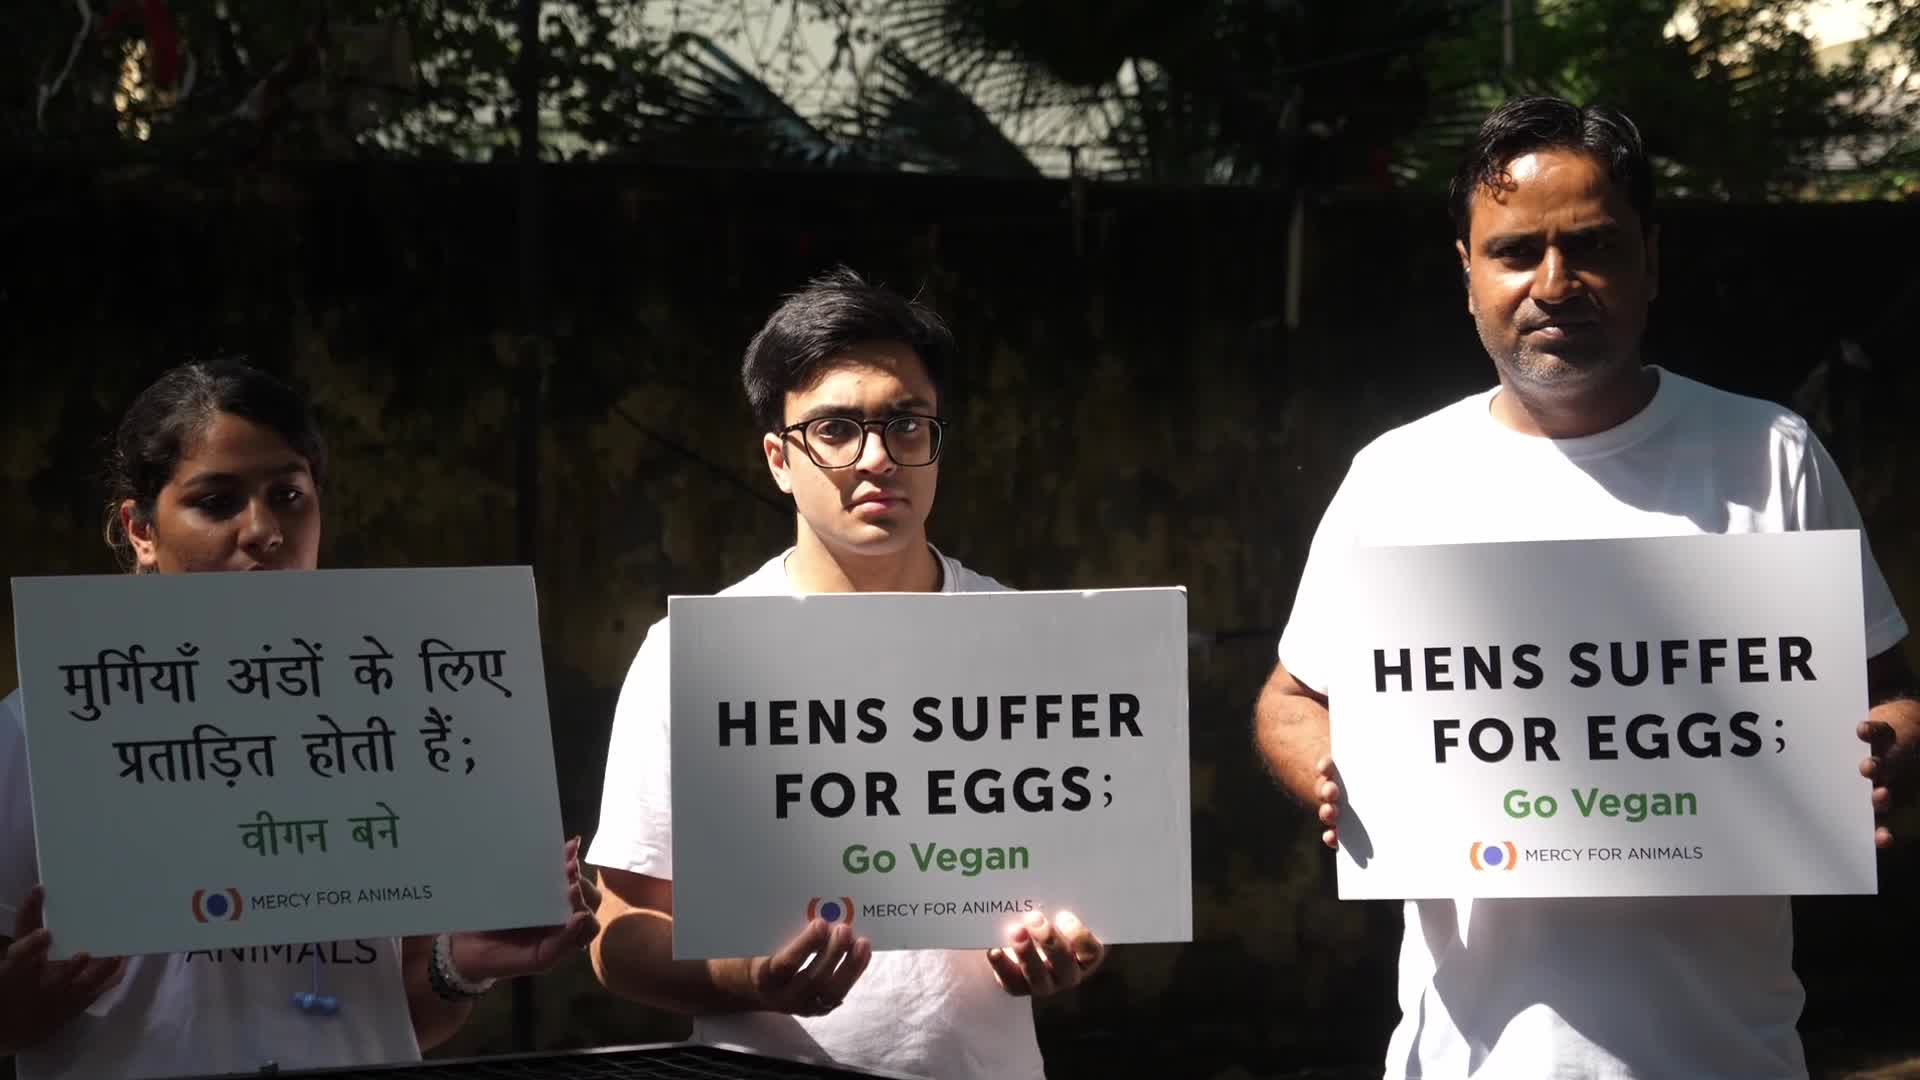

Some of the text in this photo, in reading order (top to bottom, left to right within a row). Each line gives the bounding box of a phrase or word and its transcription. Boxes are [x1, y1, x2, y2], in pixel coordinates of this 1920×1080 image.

[58, 636, 512, 722] मुर्गियाँ अंडों के लिए
[1374, 636, 1817, 692] HENS SUFFER
[719, 694, 1143, 746] HENS SUFFER
[1434, 711, 1785, 763] FOR EGGS;
[112, 707, 475, 788] प्रताड़ित होती हैं;
[776, 766, 1112, 819] FOR EGGS;
[1504, 788, 1696, 822] Go Vegan
[238, 802, 400, 856] वीगन बने
[1526, 846, 1703, 861] MERCY FOR ANIMALS
[843, 843, 1028, 877] Go Vegan
[251, 885, 432, 911] MERCY FOR ANIMALS
[863, 899, 1033, 917] MERCY FOR ANIMALS
